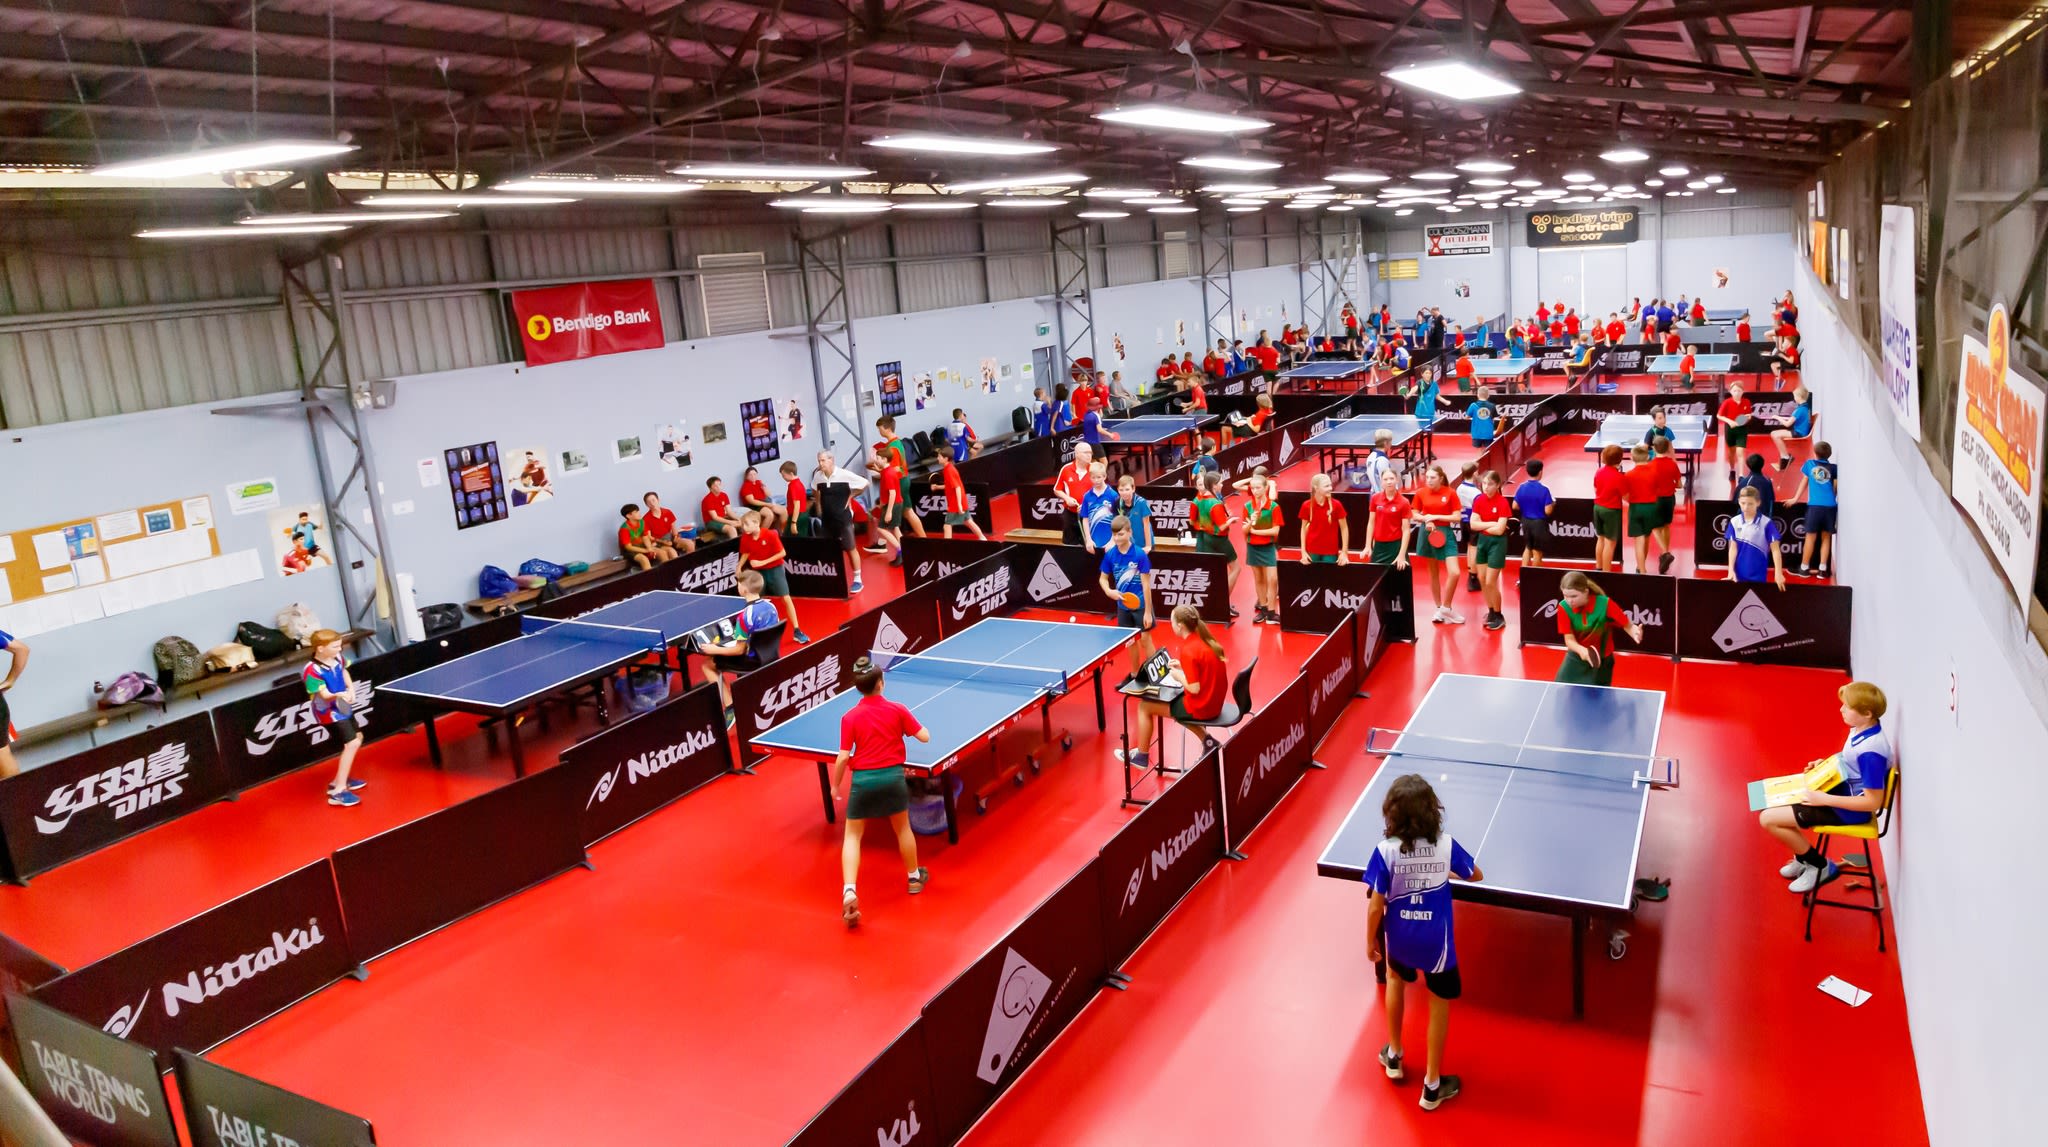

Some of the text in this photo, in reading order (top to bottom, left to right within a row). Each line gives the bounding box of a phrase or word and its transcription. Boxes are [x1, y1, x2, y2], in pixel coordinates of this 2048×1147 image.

[1553, 222, 1624, 234] electrical
[553, 308, 651, 333] Bendigo Bank
[706, 575, 738, 595] DHS
[785, 559, 837, 577] Nittaku
[952, 565, 1011, 621] 红双喜
[979, 588, 1010, 616] DHS
[1161, 591, 1209, 607] DHS
[754, 654, 841, 730] 红双喜
[627, 724, 717, 785] Nittaku
[1259, 717, 1306, 779] Nittaku
[35, 742, 190, 834] 红双喜
[109, 772, 190, 820] DHS
[1151, 800, 1215, 881] Nittaku
[1404, 879, 1431, 889] TOUCH
[1410, 895, 1423, 904] AFL
[1400, 909, 1433, 921] CRICKET
[162, 917, 326, 1017] Nittaku
[1050, 966, 1077, 1008] Australia
[32, 1040, 151, 1118] TABLE TENNIS
[45, 1070, 116, 1124] WORLD
